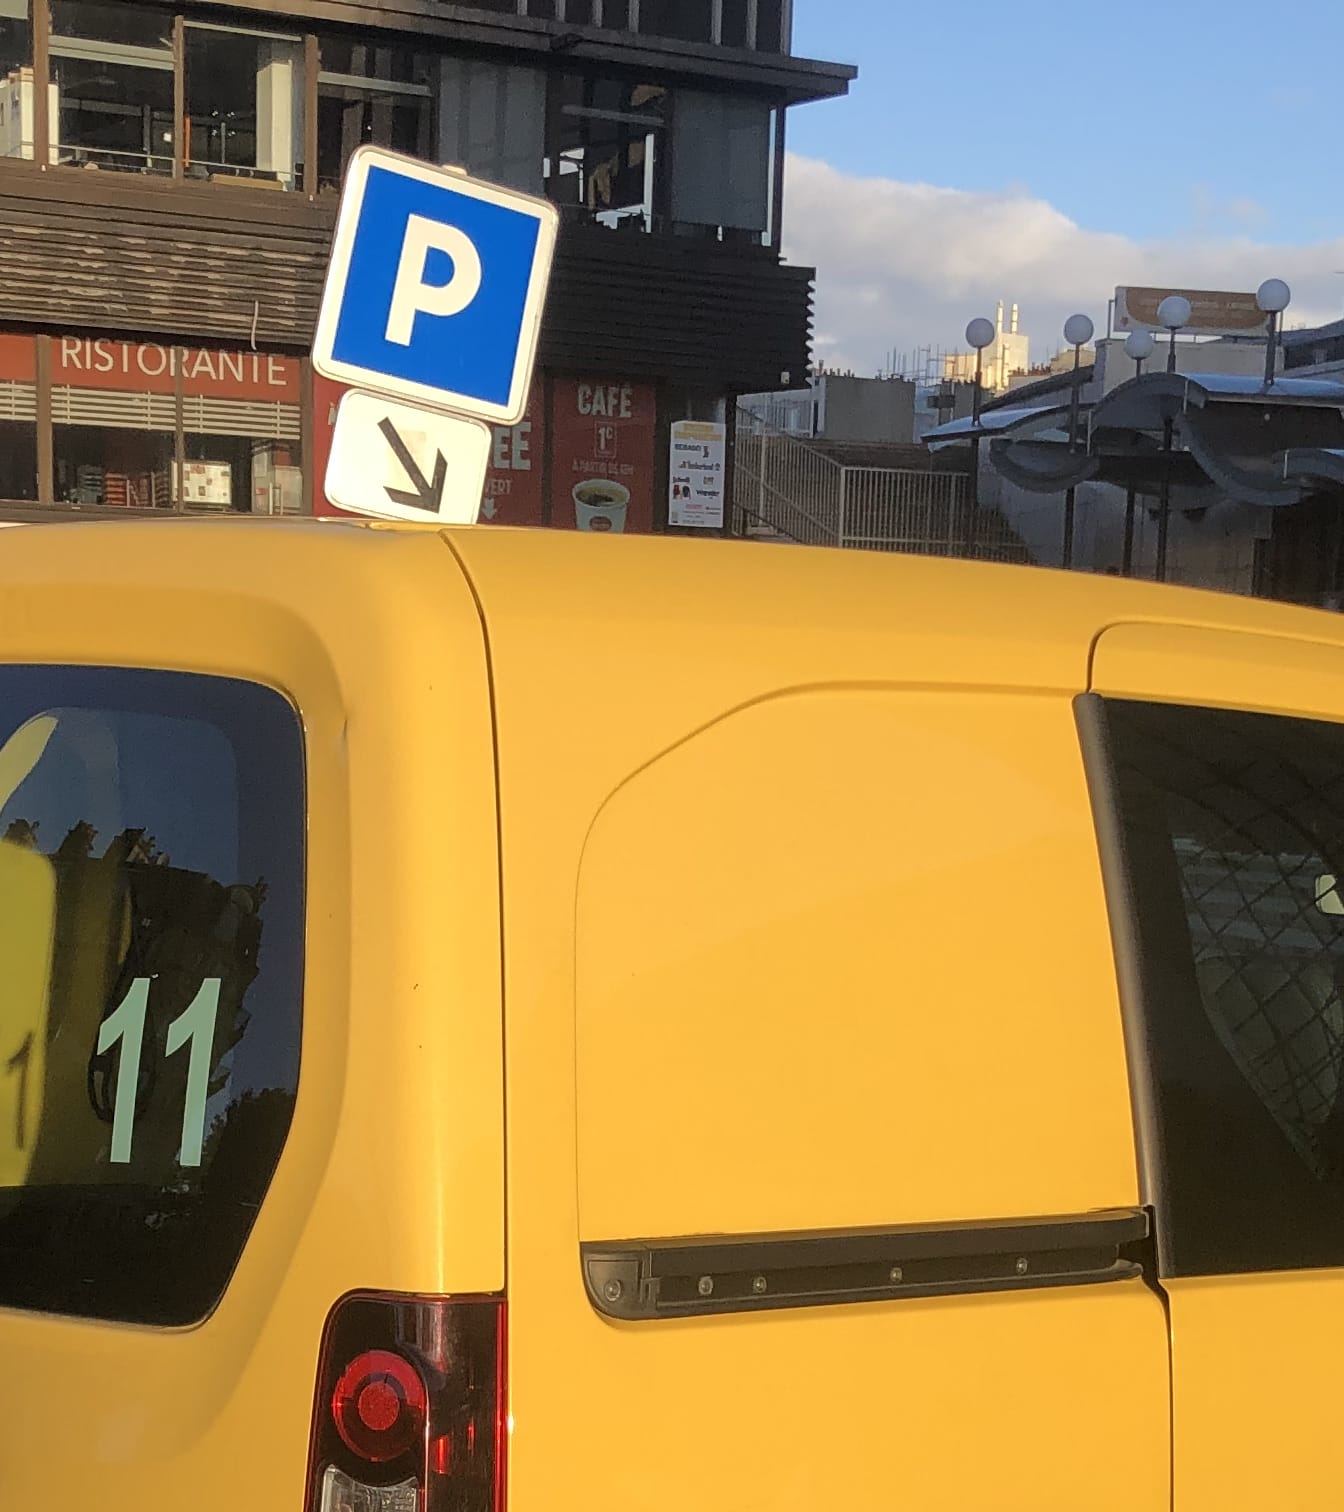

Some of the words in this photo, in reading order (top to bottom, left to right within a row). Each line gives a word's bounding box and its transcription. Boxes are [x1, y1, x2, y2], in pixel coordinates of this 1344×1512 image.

[385, 213, 482, 347] P
[61, 336, 288, 386] RISTORANTE
[577, 384, 633, 418] CAFÉ
[96, 977, 222, 1167] 11
